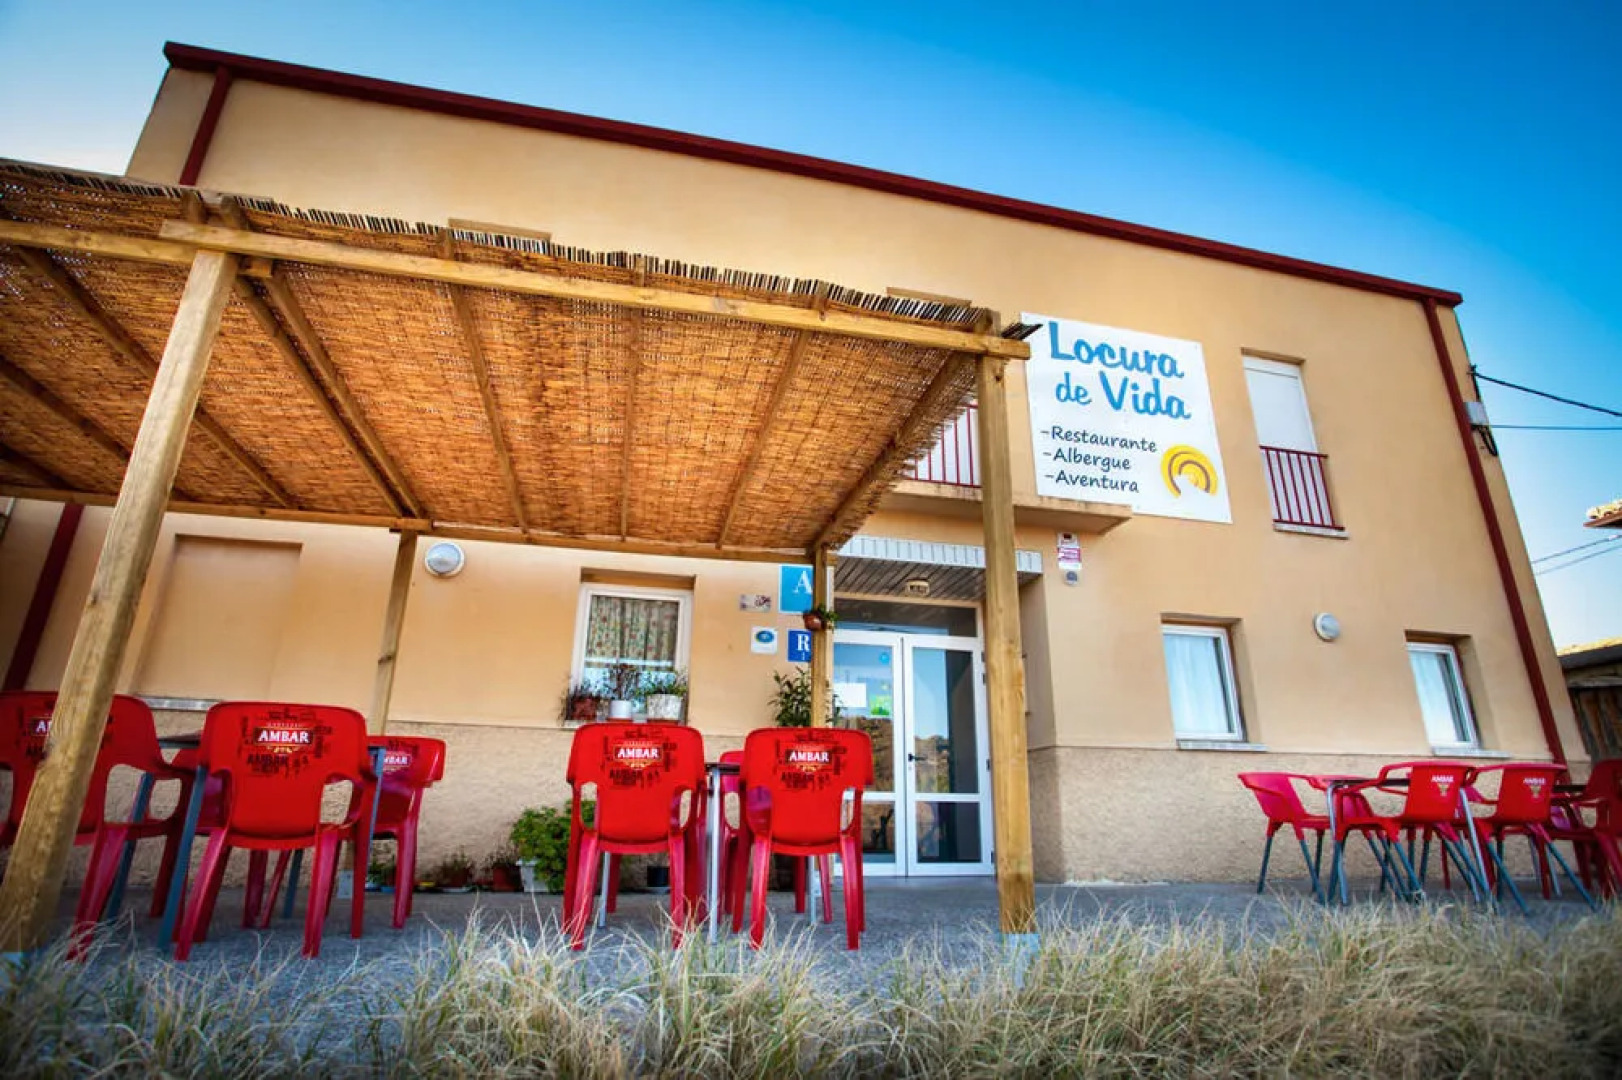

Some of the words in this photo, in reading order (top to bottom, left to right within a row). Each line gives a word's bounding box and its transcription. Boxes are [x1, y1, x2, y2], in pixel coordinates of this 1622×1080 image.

[1048, 321, 1185, 379] Locura
[1055, 372, 1092, 406] de
[1098, 370, 1192, 420] Vida
[1040, 426, 1158, 453] -Restaurante
[1043, 448, 1131, 473] -Albergue
[1045, 470, 1139, 493] -Aventura
[792, 570, 813, 594] A
[797, 633, 810, 652] R
[257, 730, 309, 743] AMBAR
[617, 748, 659, 759] AMBAR
[789, 751, 830, 763] AMBAR
